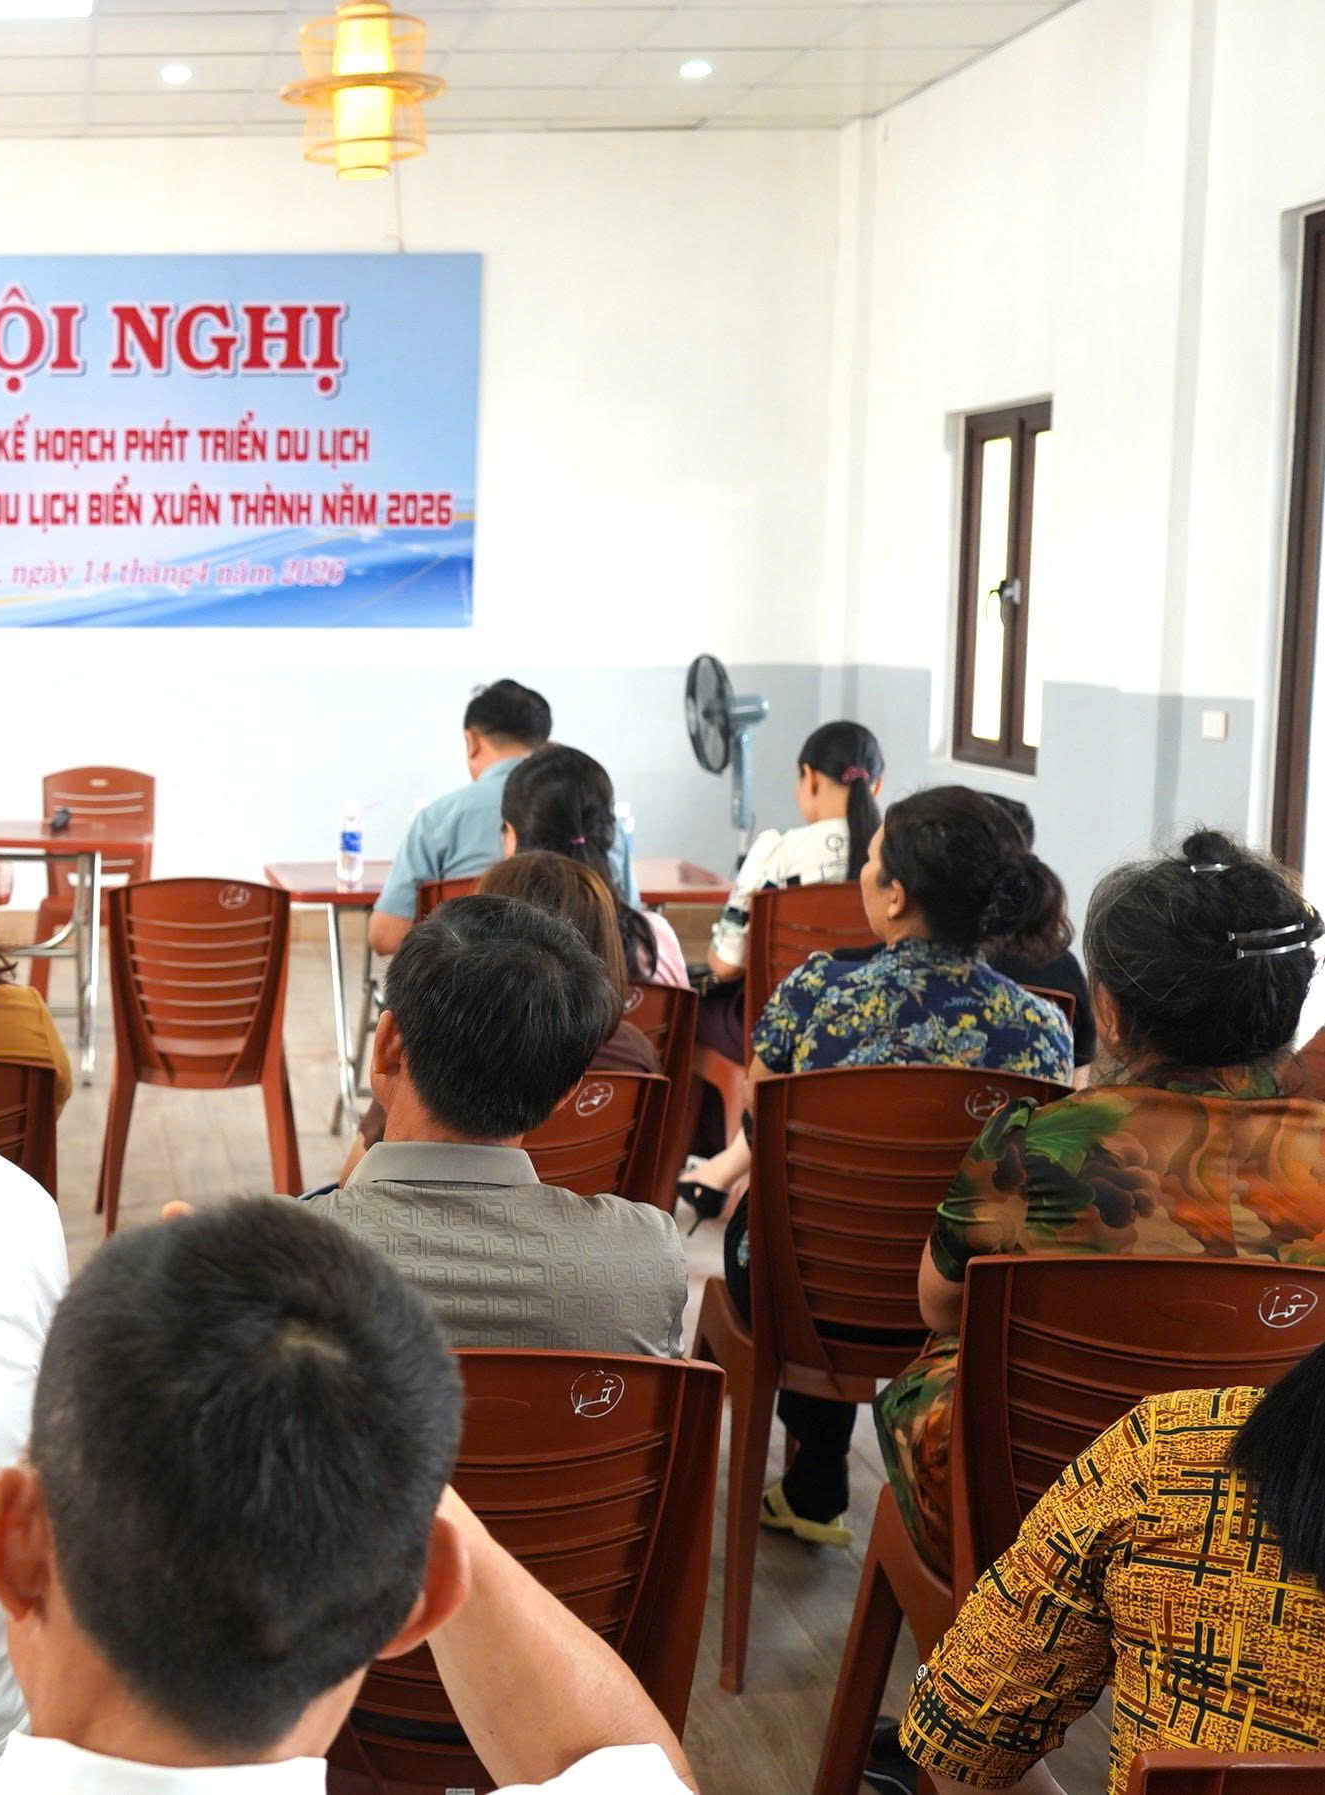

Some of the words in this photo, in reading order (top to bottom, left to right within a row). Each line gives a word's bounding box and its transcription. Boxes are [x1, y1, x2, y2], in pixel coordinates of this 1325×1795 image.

[111, 304, 342, 393] NGHỊ
[34, 428, 116, 470] HOẠCH
[124, 418, 189, 463] PHÁT
[197, 411, 268, 463] TRIỂN
[276, 428, 310, 463] DU
[318, 428, 370, 470] LỊCH
[29, 492, 79, 533] LỊCH
[87, 475, 143, 526] BIỂN
[151, 482, 221, 526] XUÂN
[229, 481, 313, 526] THÀNH
[321, 482, 378, 526] NĂM
[385, 493, 452, 527] 2026
[10, 559, 74, 589] ngày
